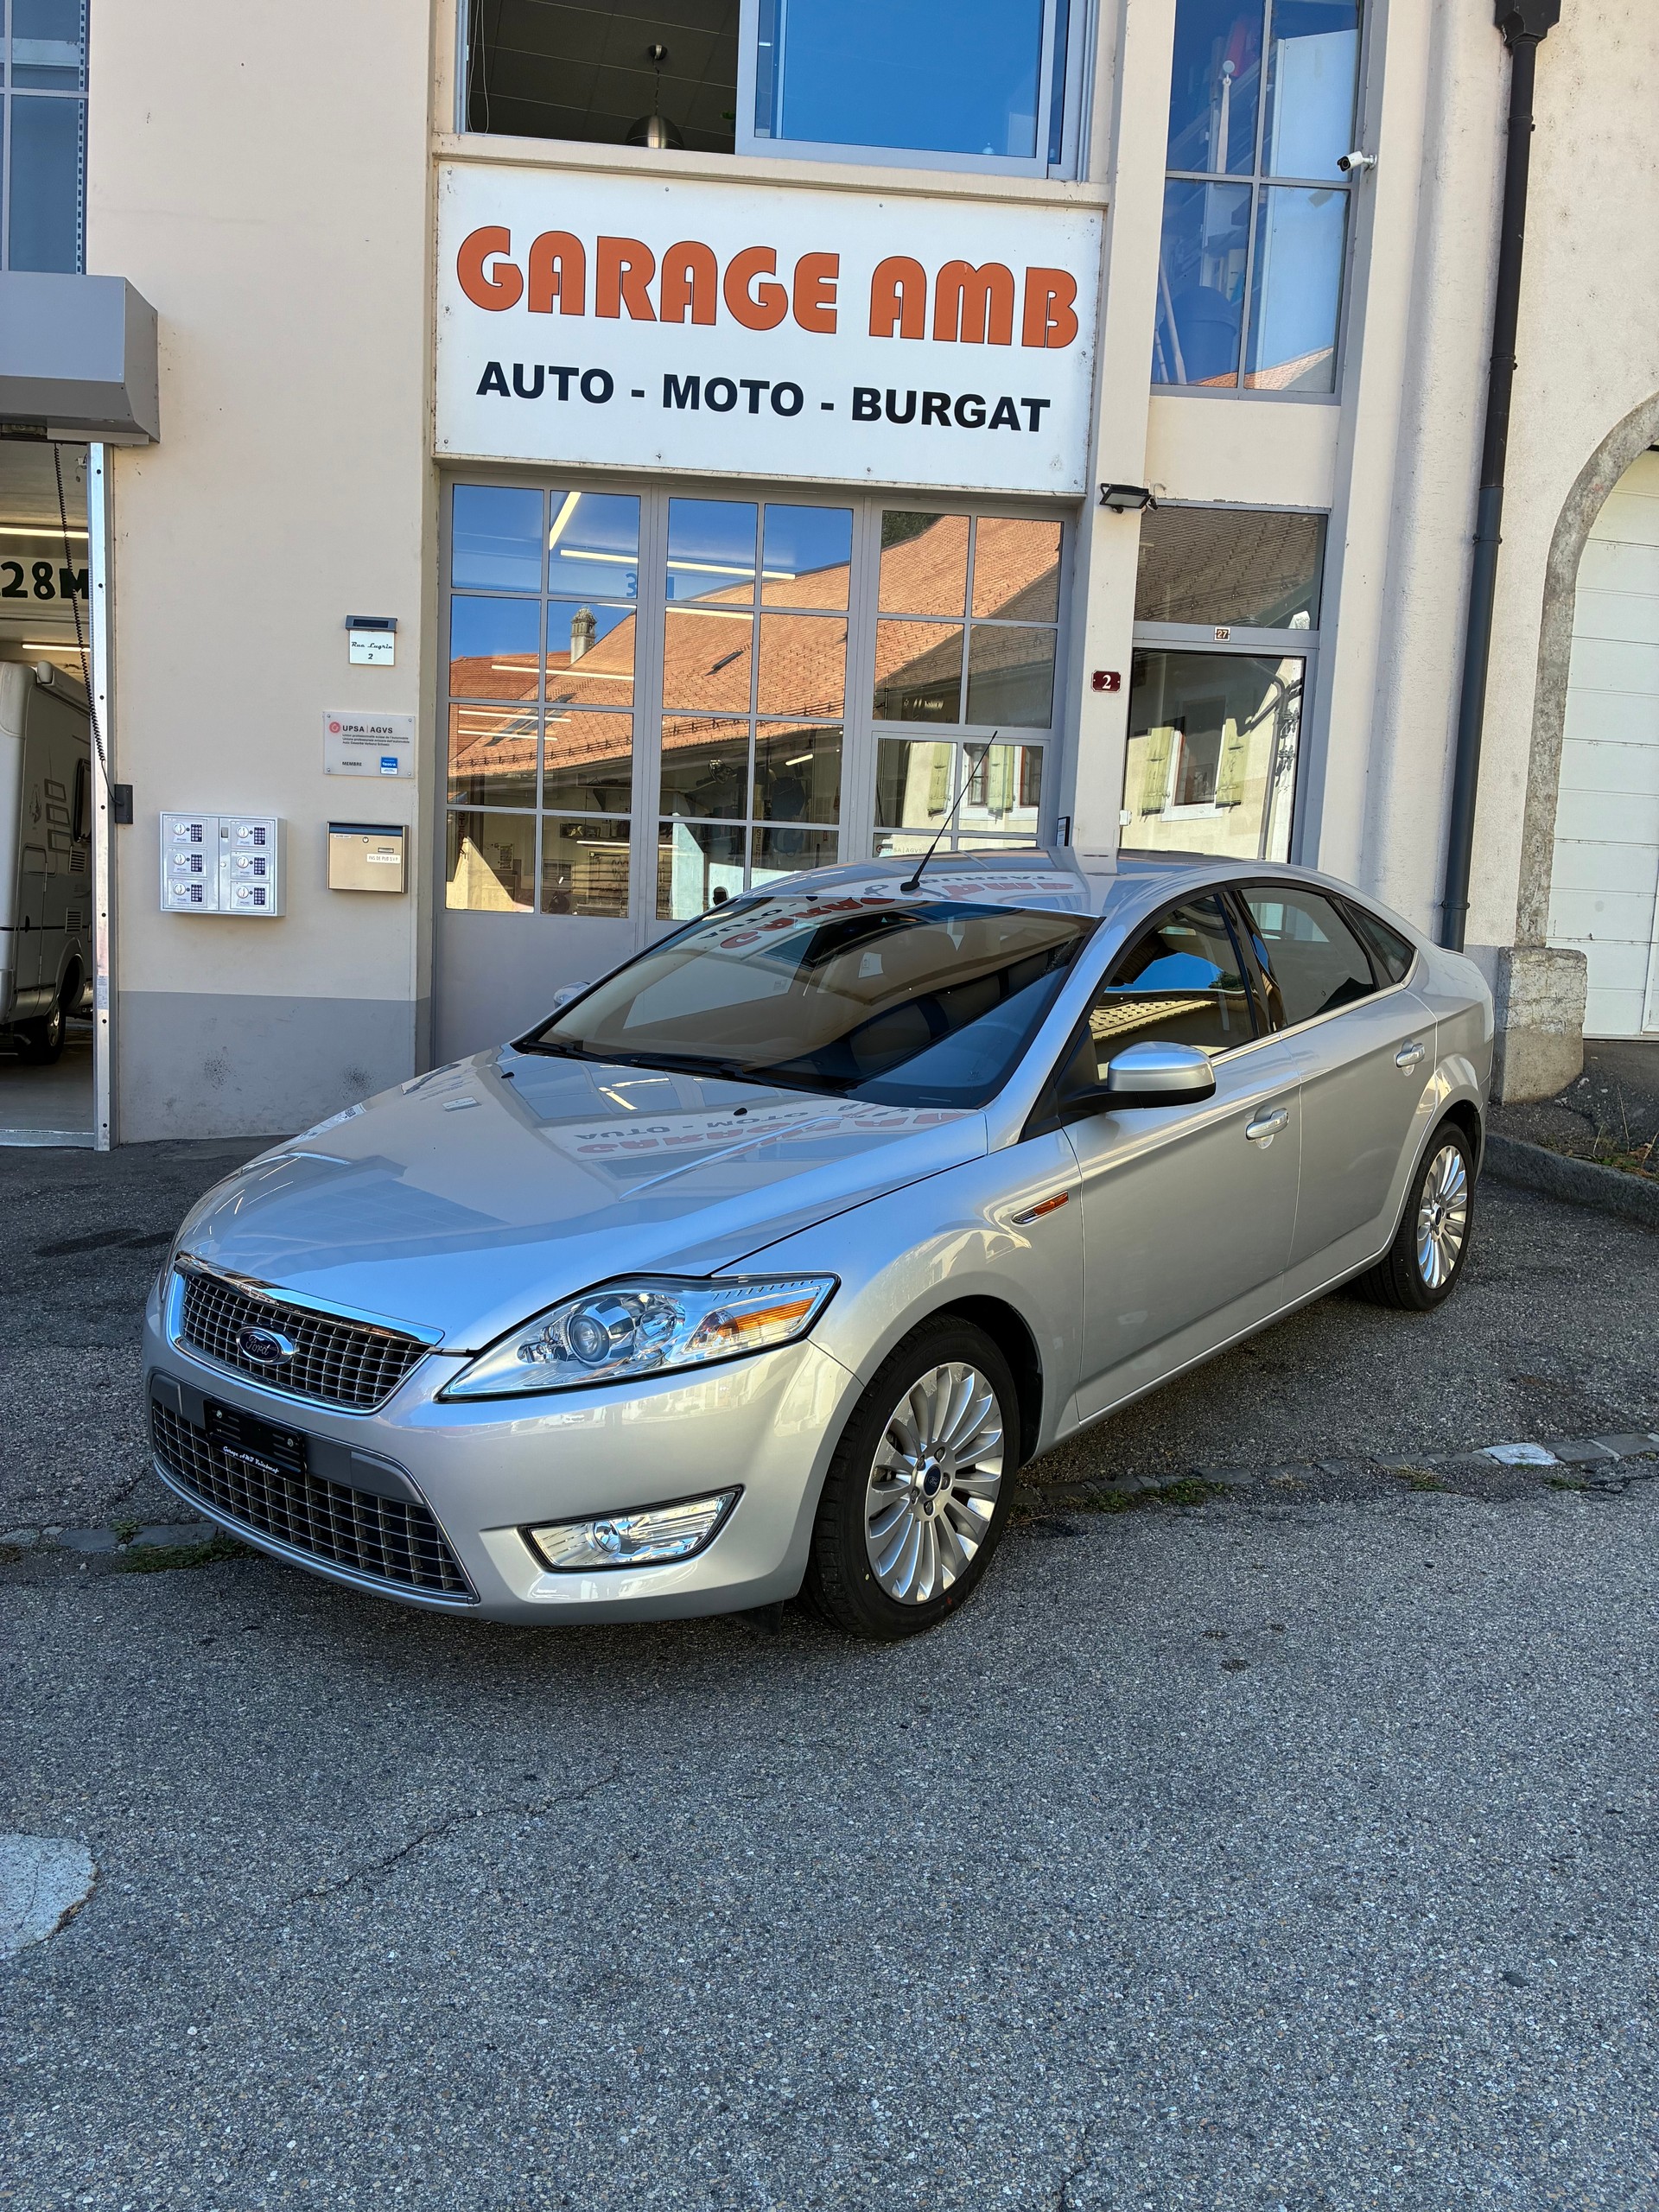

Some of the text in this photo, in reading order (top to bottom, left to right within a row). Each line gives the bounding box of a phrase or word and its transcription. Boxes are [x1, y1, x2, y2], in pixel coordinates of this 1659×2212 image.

[456, 225, 1079, 349] GARAGE AMB
[476, 360, 614, 404] AUTO
[663, 373, 804, 416] MOTO
[851, 386, 1051, 432] BURGAT
[1217, 630, 1228, 639] 27
[1102, 674, 1111, 690] 2
[245, 1334, 271, 1356] Ford
